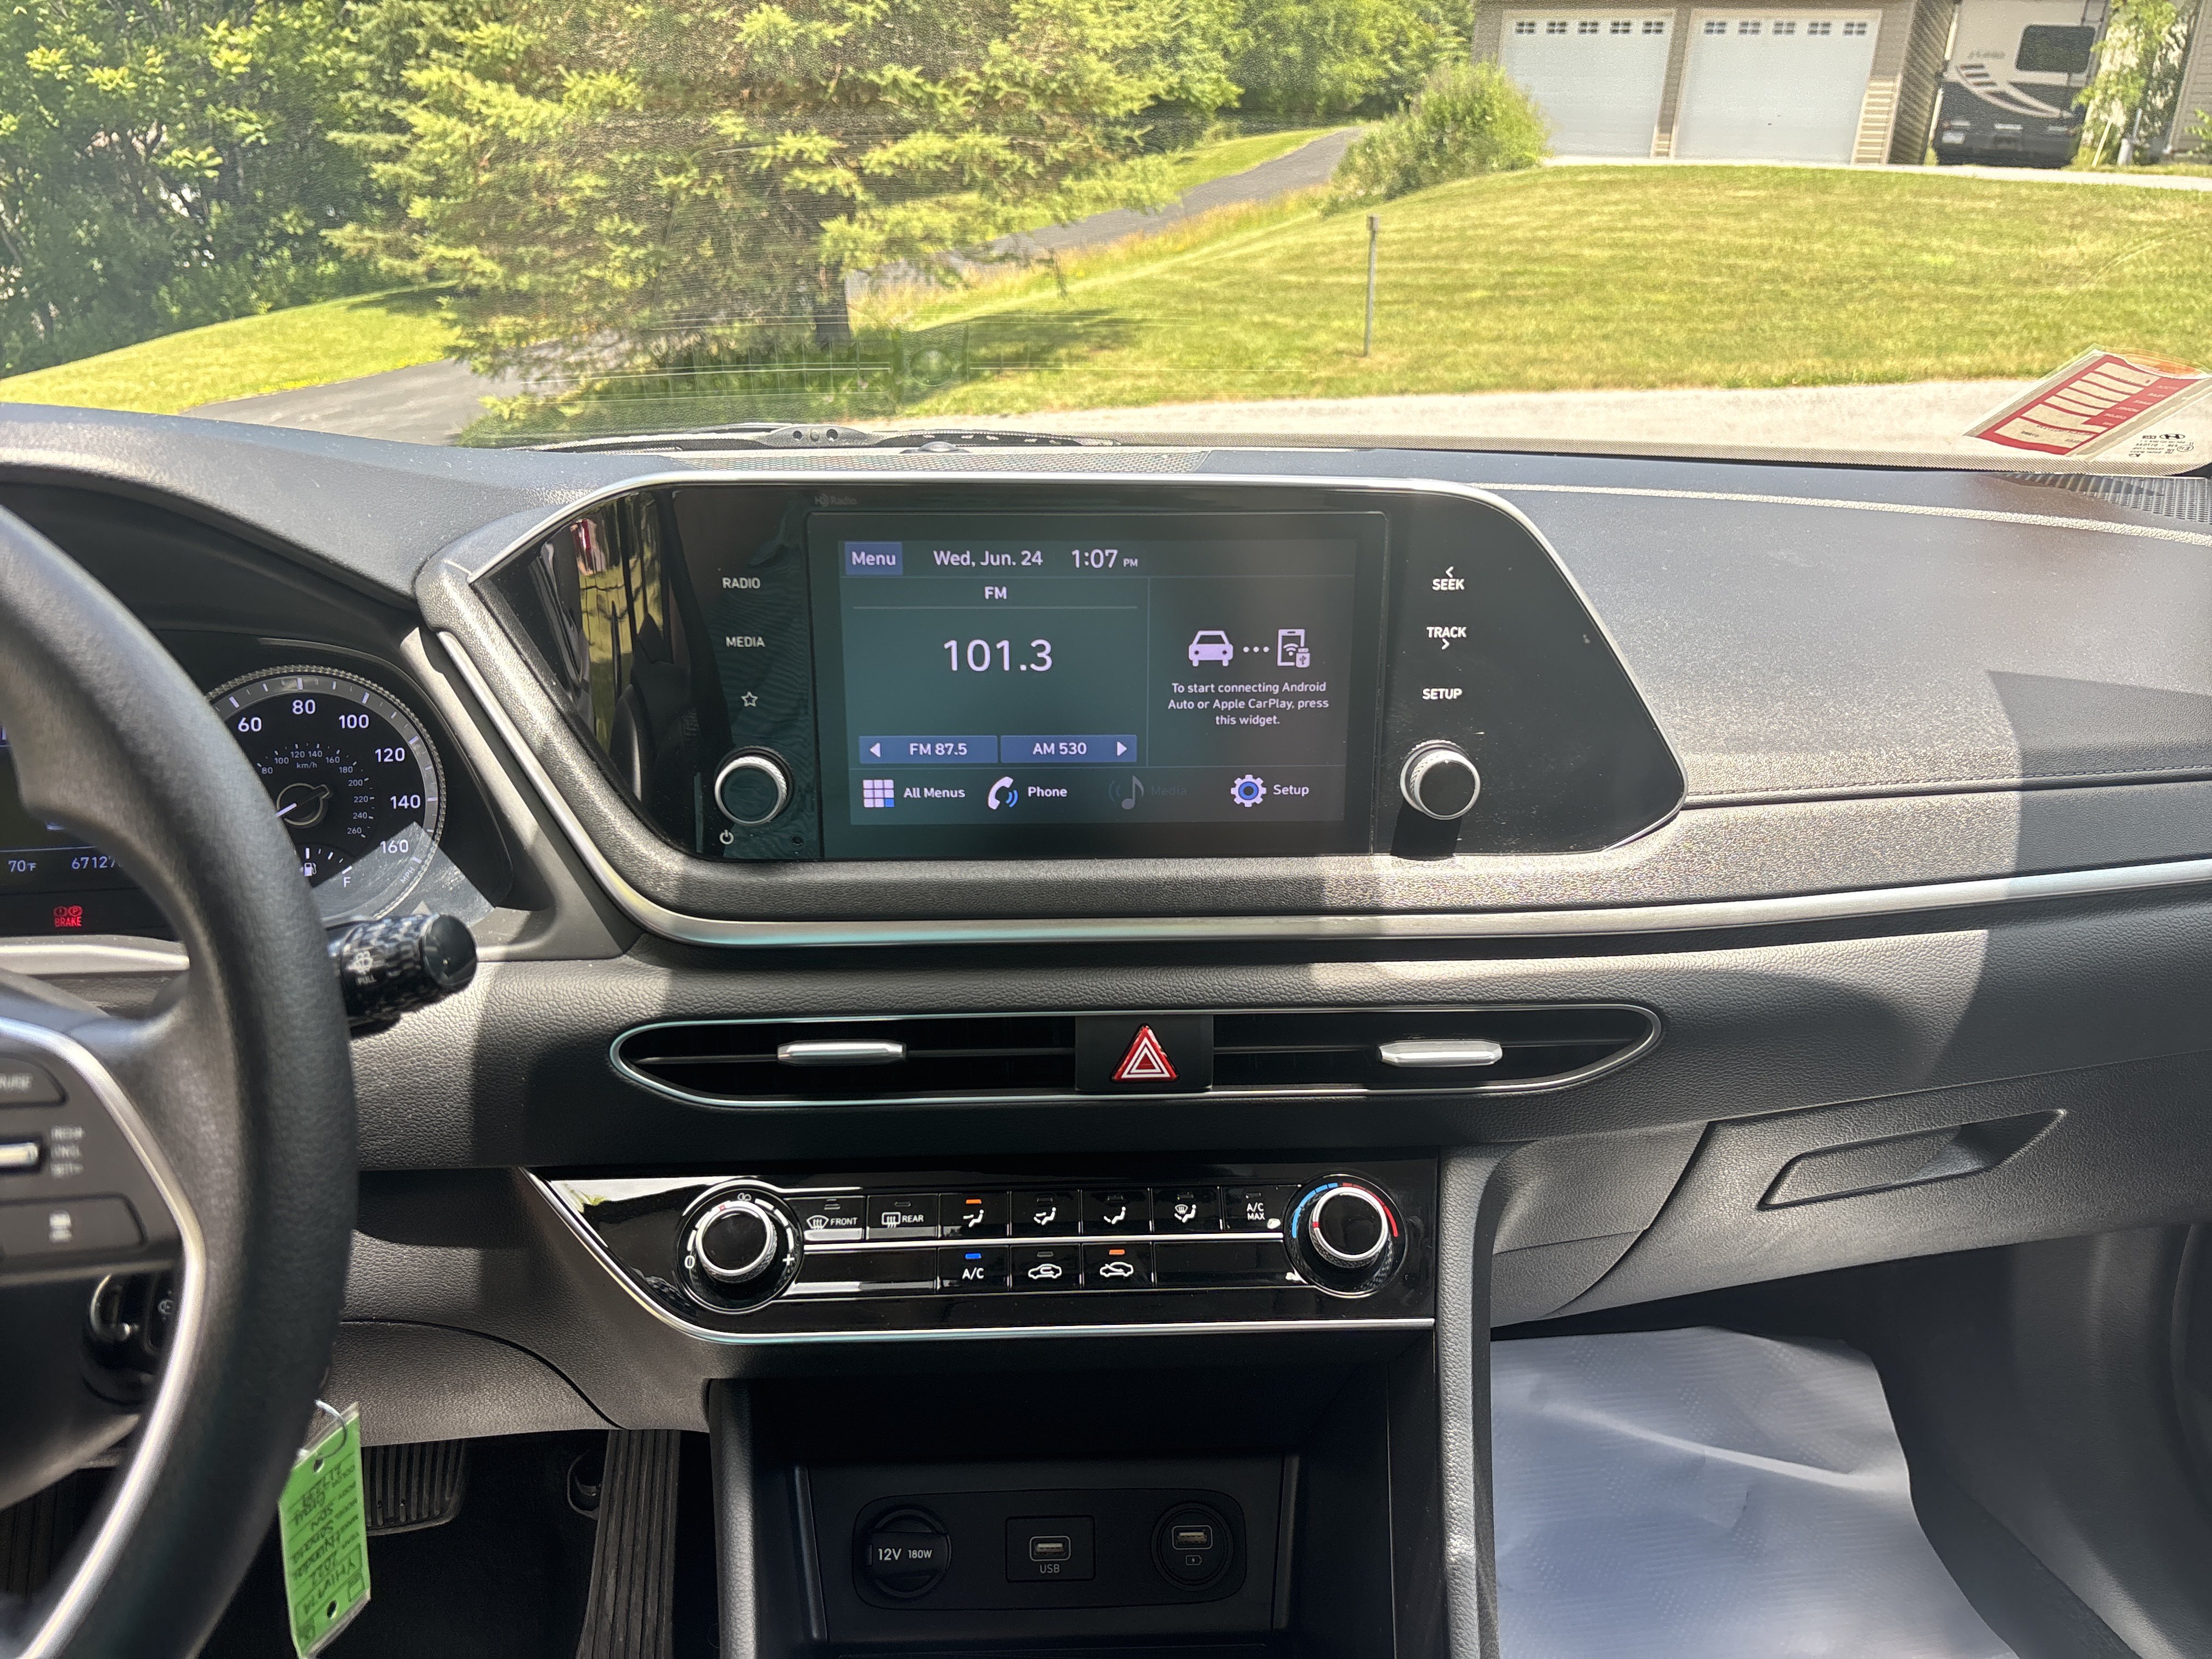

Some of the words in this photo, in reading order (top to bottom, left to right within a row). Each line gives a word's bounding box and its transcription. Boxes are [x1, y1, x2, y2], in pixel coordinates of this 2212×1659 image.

[831, 495, 857, 505] Radio
[851, 551, 896, 566] Menu
[933, 551, 977, 568] Wed,
[980, 551, 1016, 566] Jun.
[1020, 551, 1043, 566] 24
[1071, 549, 1117, 568] 1:07
[1123, 558, 1138, 568] PM
[722, 577, 760, 589] RADIO
[1432, 579, 1464, 590] SEEK
[984, 587, 1007, 600] FM
[1426, 627, 1466, 638] TRACK
[725, 637, 765, 648] MEDIA
[943, 639, 1053, 672] 101.3
[1172, 682, 1185, 693] To
[1188, 683, 1215, 693] start
[1217, 682, 1279, 695] connecting
[1283, 681, 1327, 692] Android
[1422, 688, 1462, 700] SETUP
[292, 699, 315, 714] 80
[1168, 699, 1194, 709] Auto
[1197, 700, 1209, 709] or
[1212, 698, 1245, 712] Apple
[1248, 698, 1295, 711] CarPlay,
[1298, 699, 1329, 710] press
[238, 718, 262, 732] 60
[338, 715, 369, 729] 100
[1215, 715, 1235, 725] this
[1239, 714, 1280, 726] widget.
[910, 743, 932, 755] FM
[935, 743, 967, 756] 87.5
[1032, 743, 1056, 755] AM
[1059, 743, 1087, 755] 530
[375, 748, 405, 763] 120
[904, 787, 921, 799] All
[923, 787, 966, 799] Menus
[1028, 786, 1068, 798] Phone
[1150, 786, 1188, 797] Media
[1273, 783, 1310, 797] Setup
[391, 794, 420, 809] 140
[380, 839, 409, 854] 160
[400, 867, 415, 883] MPH
[343, 877, 350, 887] F
[55, 917, 82, 927] BRAKE
[1246, 1202, 1264, 1212] A/C
[830, 1217, 858, 1226] FRONT
[902, 1215, 924, 1223] REAR
[962, 1267, 984, 1280] A/C
[878, 1548, 902, 1561] 12V
[907, 1549, 933, 1559] 180W
[1039, 1564, 1060, 1574] USB
